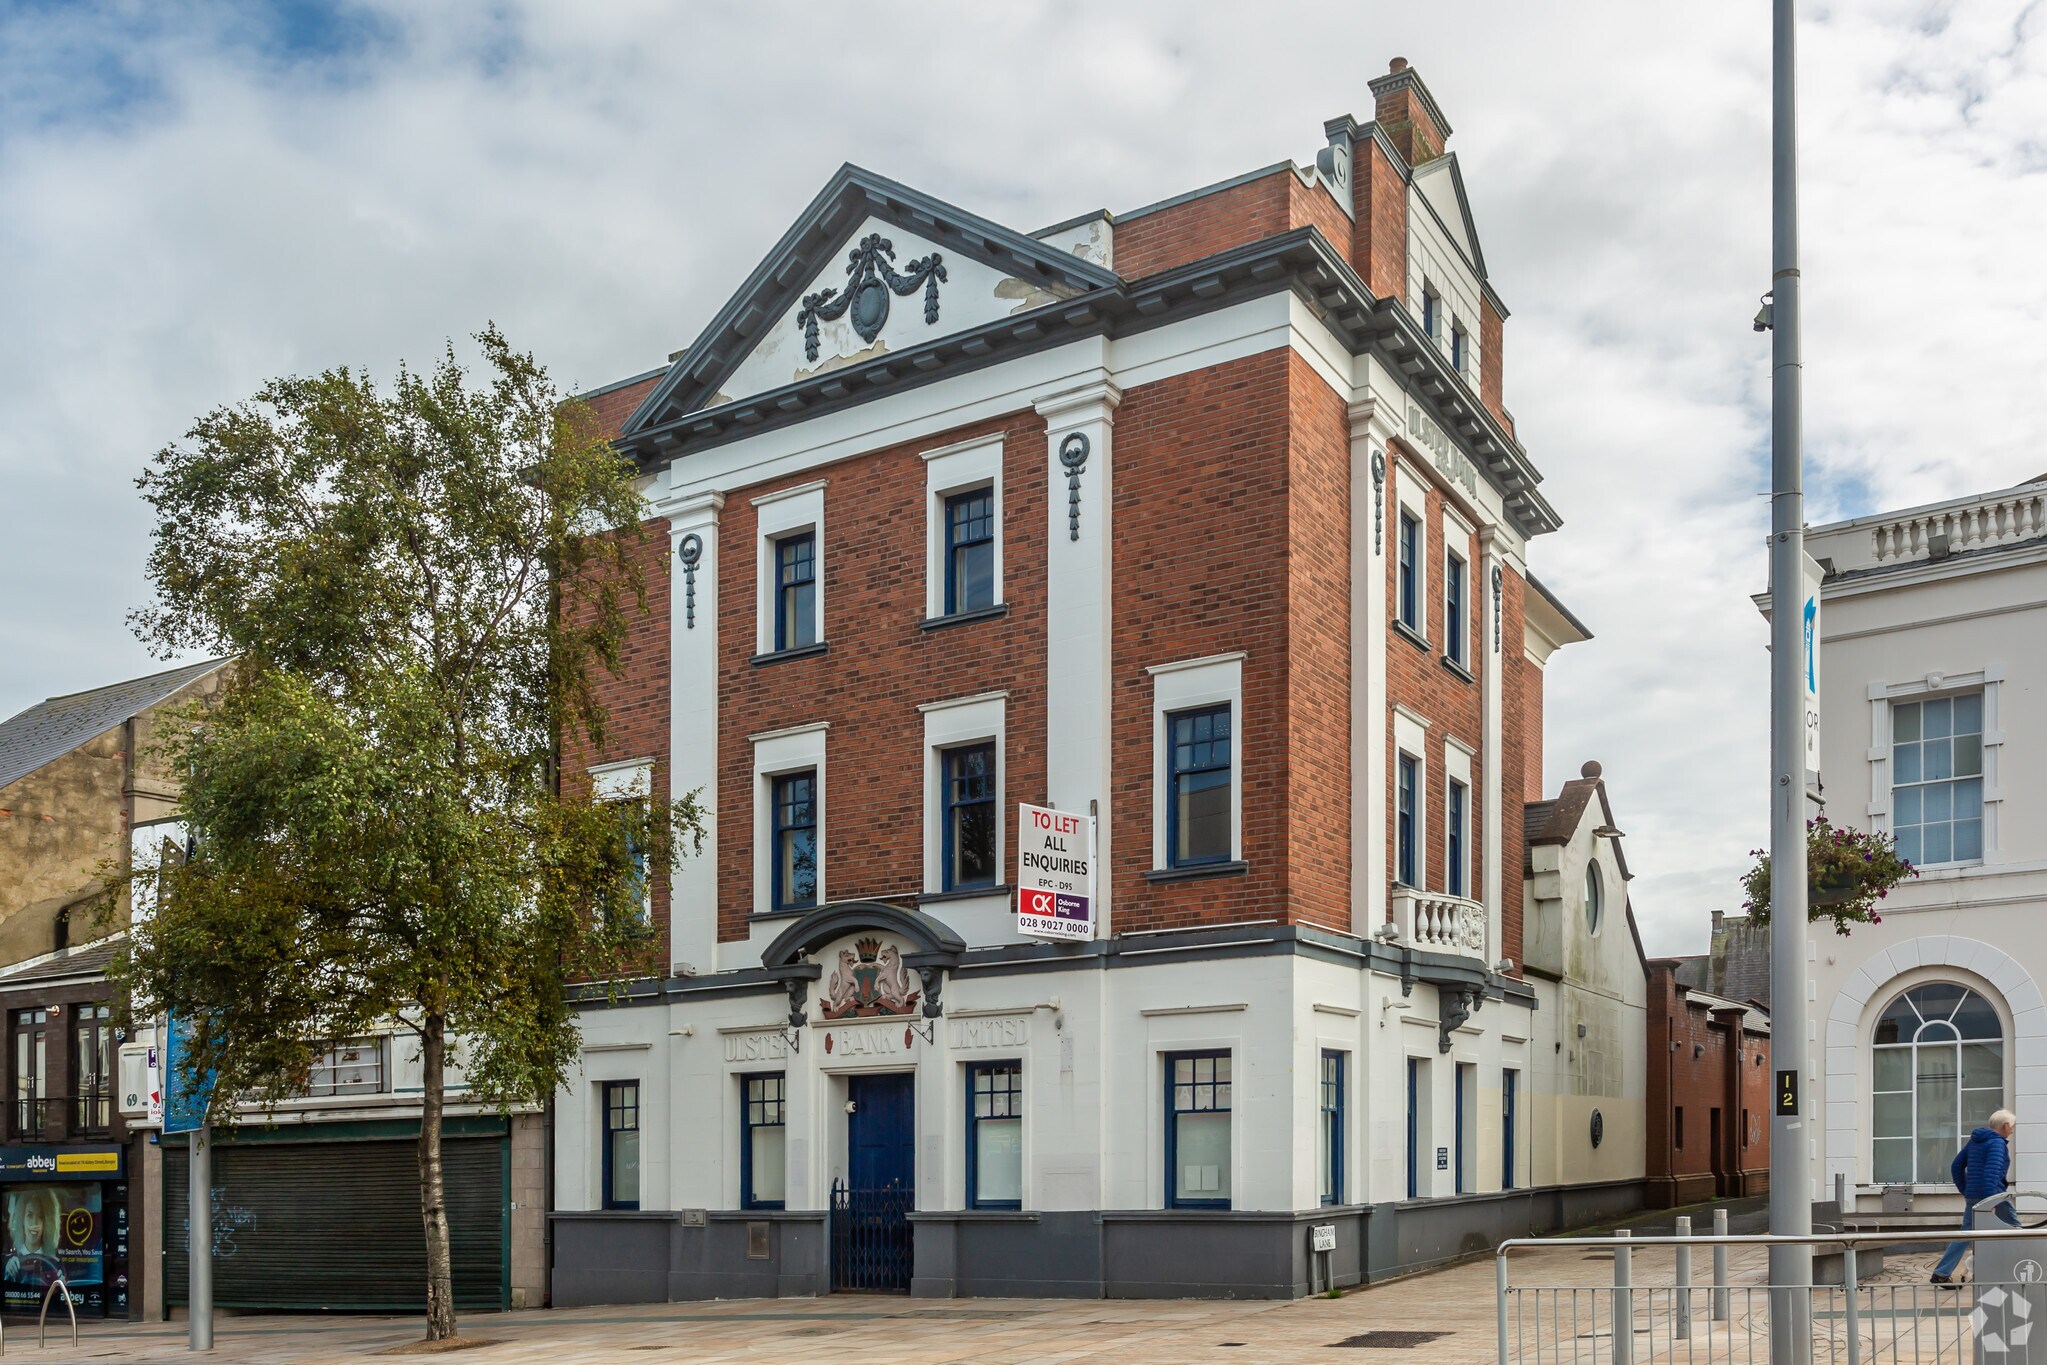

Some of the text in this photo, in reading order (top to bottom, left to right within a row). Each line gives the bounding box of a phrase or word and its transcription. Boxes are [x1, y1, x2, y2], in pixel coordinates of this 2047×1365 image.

[1032, 810, 1079, 834] TO LET
[1044, 835, 1067, 853] ALL
[1023, 851, 1088, 876] ENQUIRIES
[1038, 878, 1053, 888] EPC
[1059, 881, 1073, 891] D95
[1057, 898, 1080, 908] Osborne
[1057, 905, 1071, 915] King
[1020, 917, 1089, 934] 028 9027 0000
[950, 1018, 1029, 1049] LIMITED
[839, 1028, 897, 1056] BANK
[126, 1093, 138, 1107] 69
[26, 1155, 56, 1171] abbey
[1314, 1227, 1335, 1238] BINGHAM
[1318, 1238, 1331, 1248] LANE
